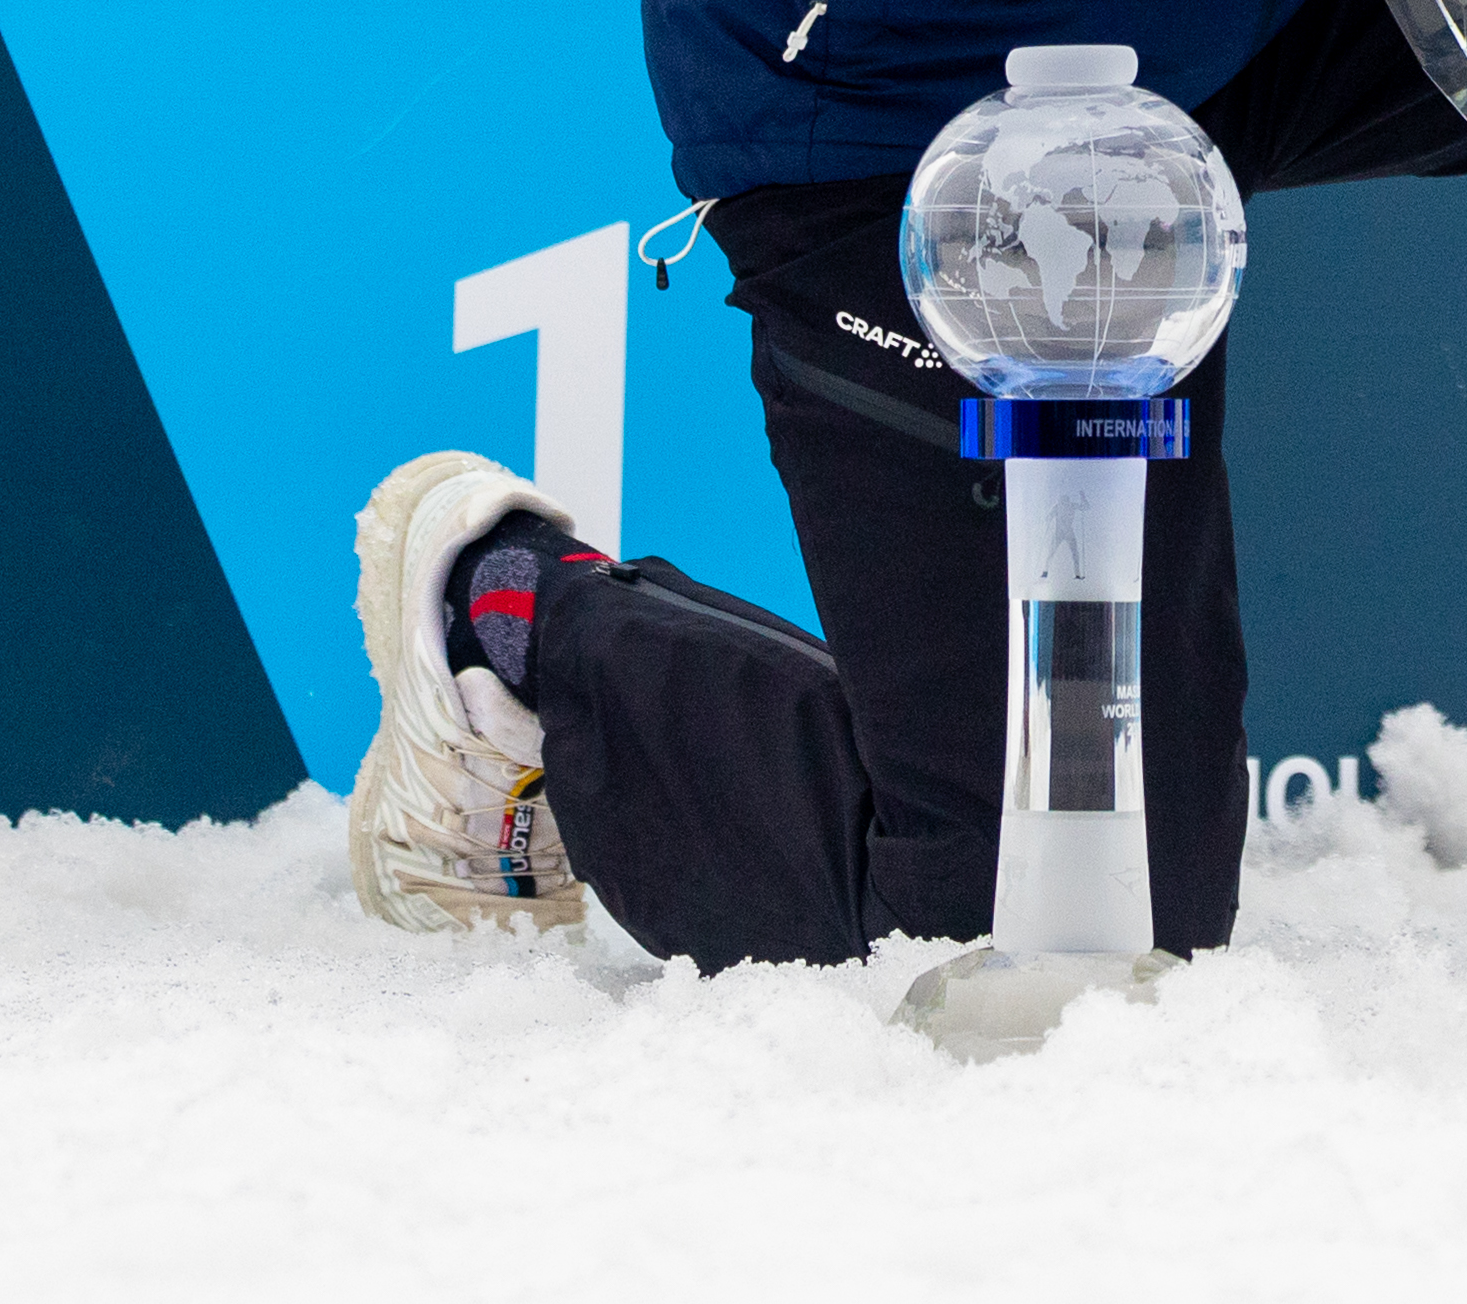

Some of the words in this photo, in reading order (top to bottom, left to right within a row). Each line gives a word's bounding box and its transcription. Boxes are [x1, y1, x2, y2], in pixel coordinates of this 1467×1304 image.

[836, 311, 921, 358] CRAFT
[453, 221, 630, 563] 1
[1075, 419, 1175, 438] INTERNATION
